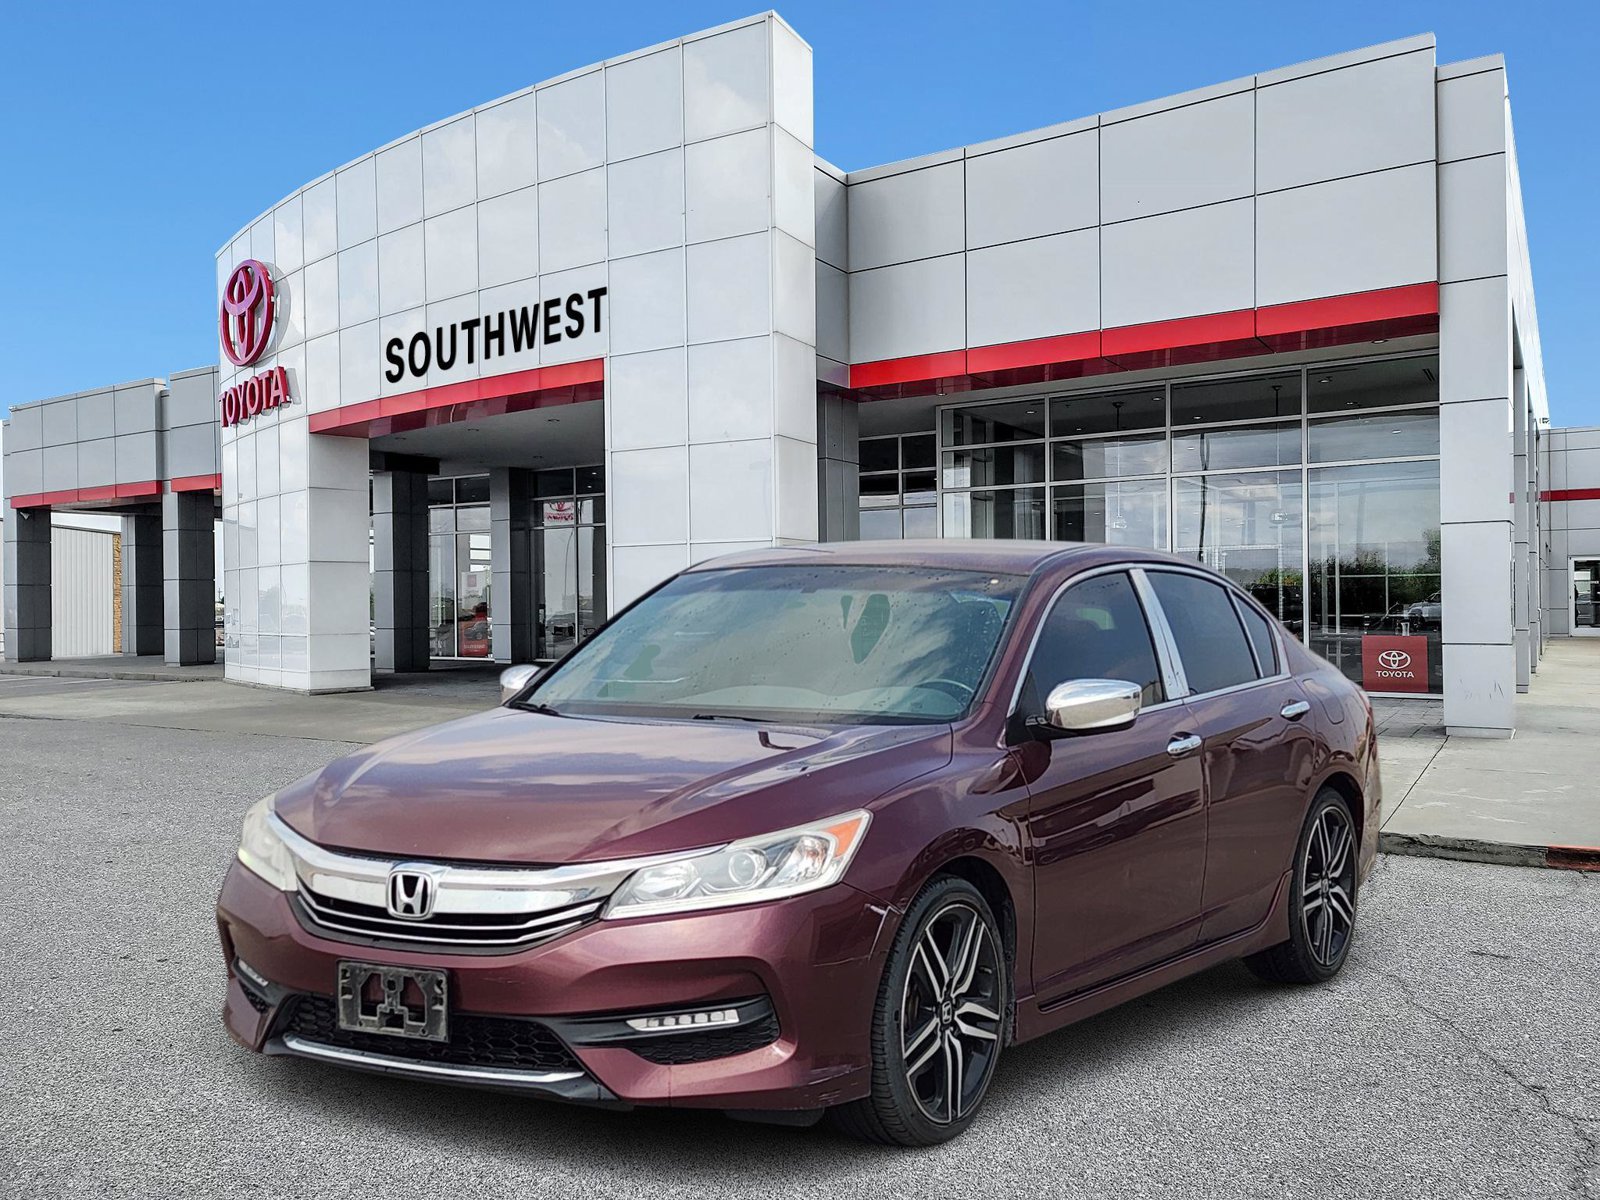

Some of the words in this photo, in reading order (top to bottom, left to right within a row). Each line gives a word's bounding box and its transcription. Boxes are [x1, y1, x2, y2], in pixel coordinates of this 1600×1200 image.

[385, 286, 608, 384] SOUTHWEST
[218, 365, 290, 428] TOYOTA
[1375, 670, 1415, 678] TOYOTA
